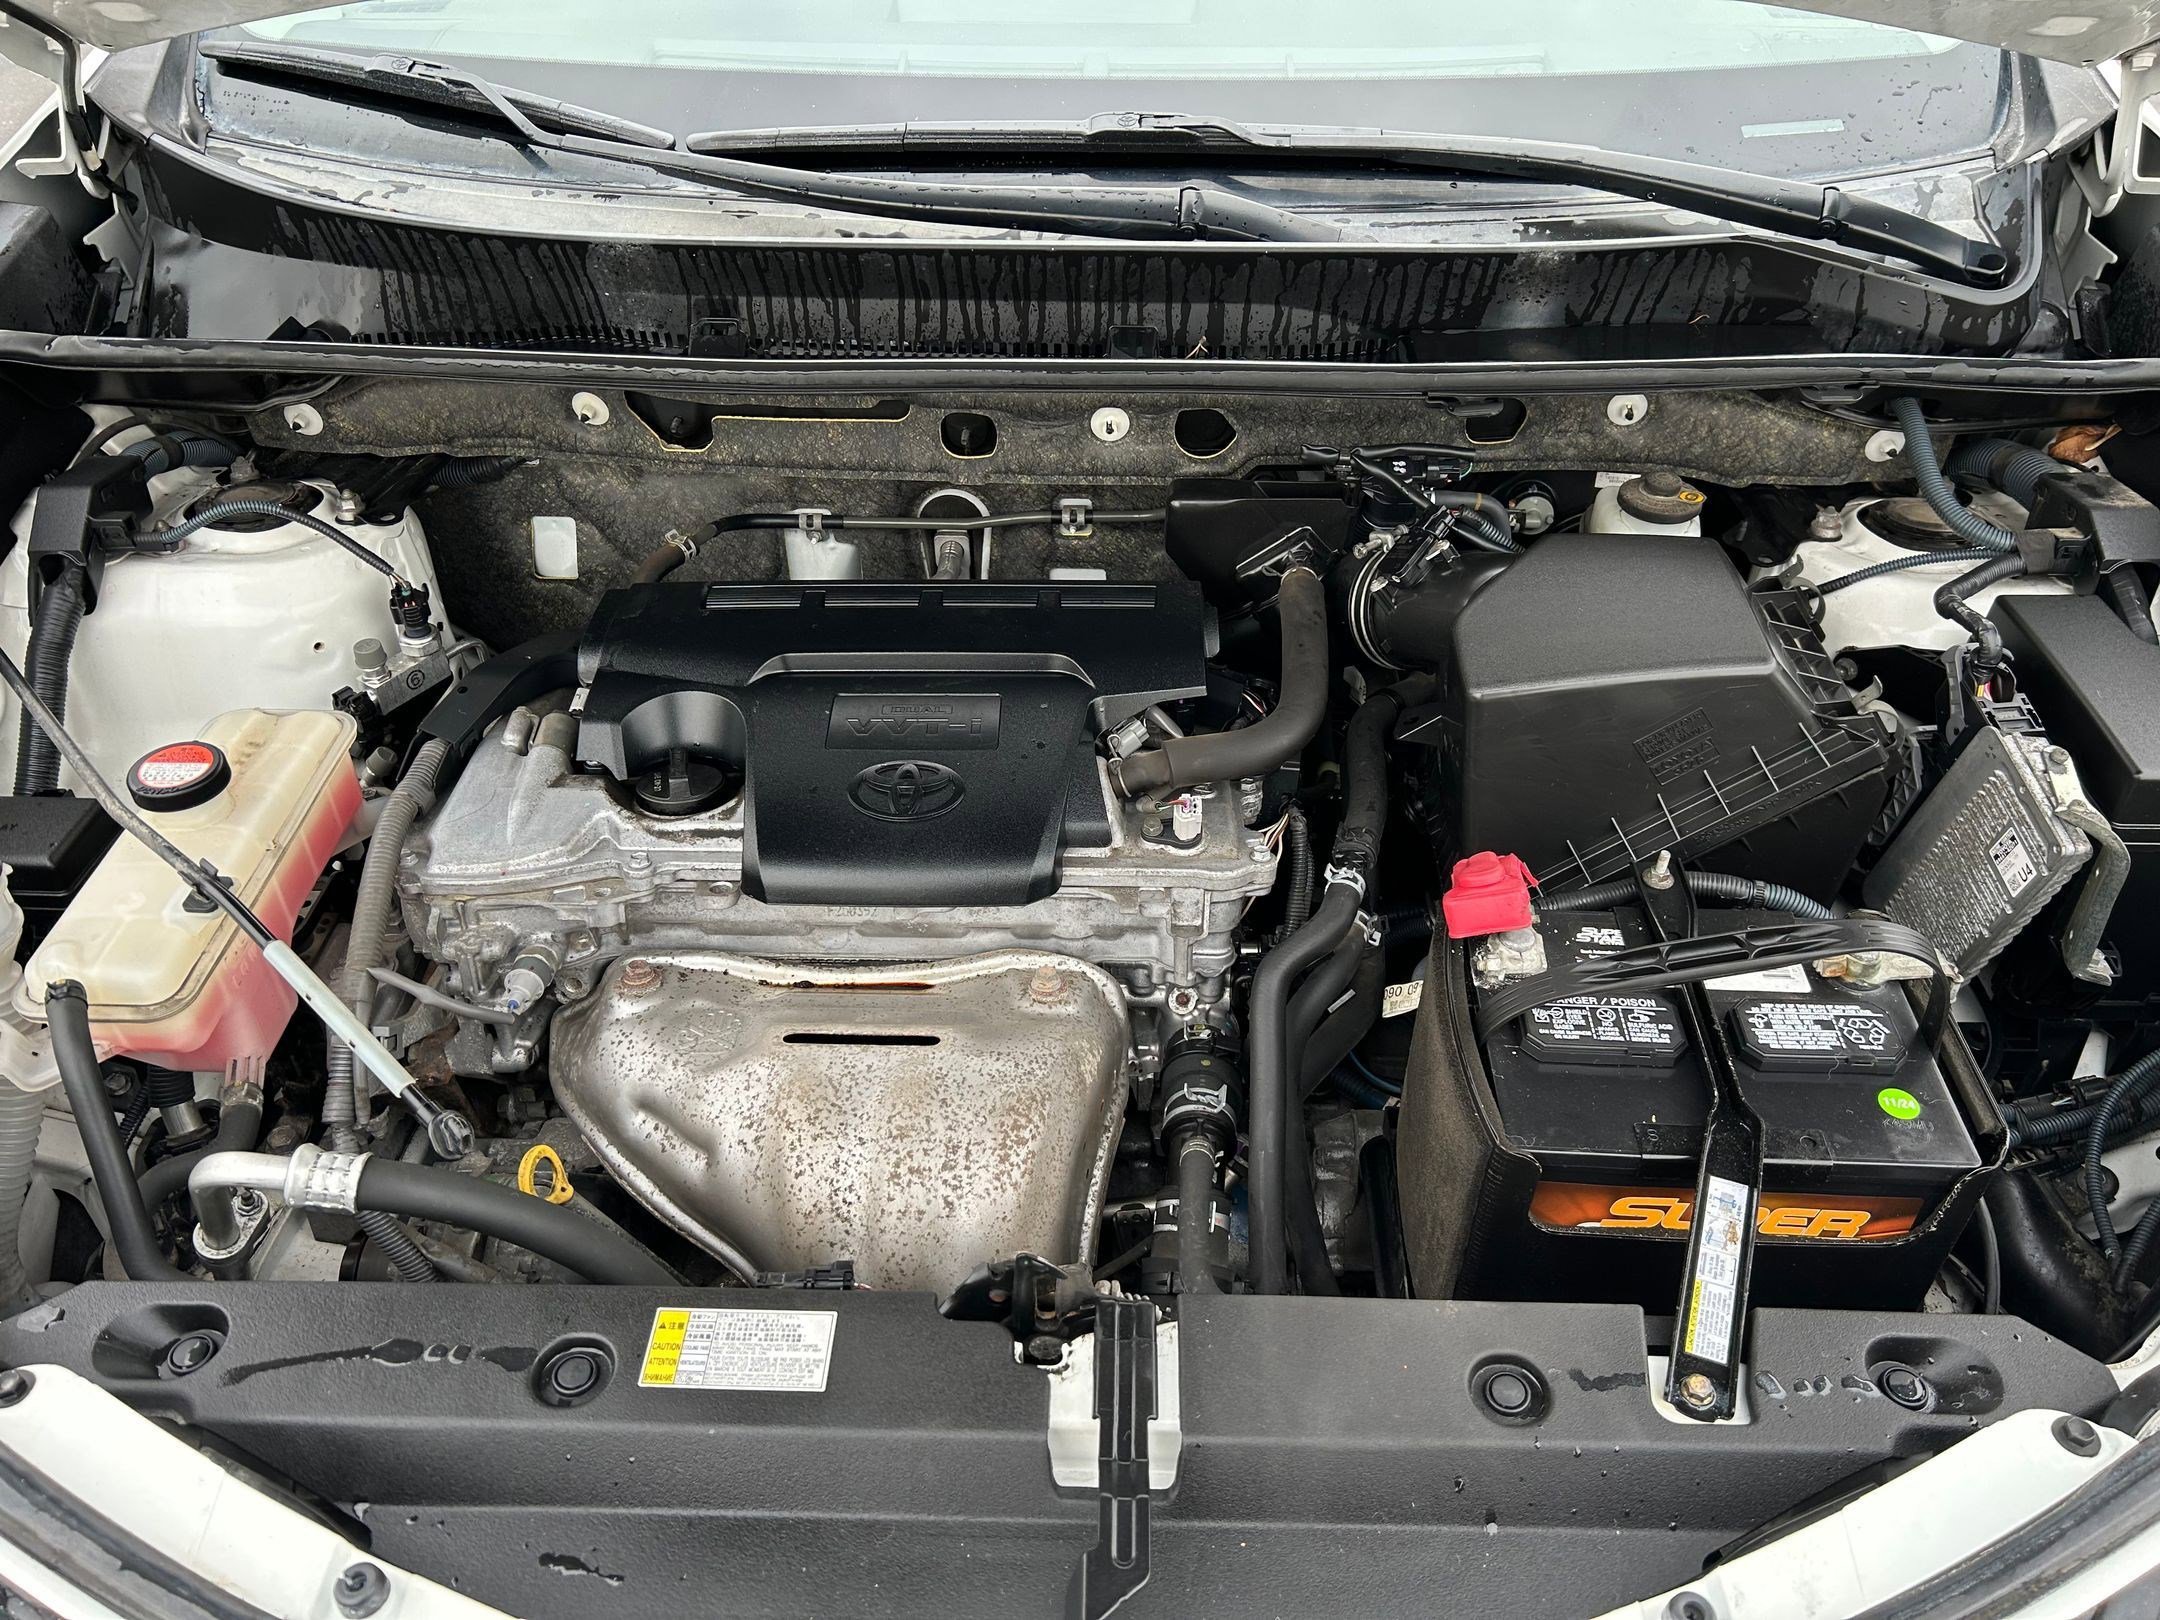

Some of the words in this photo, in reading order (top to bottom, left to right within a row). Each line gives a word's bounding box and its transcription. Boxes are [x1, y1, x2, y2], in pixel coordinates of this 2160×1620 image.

[890, 704, 947, 713] DUAL
[2018, 863, 2033, 882] U4
[1552, 996, 1598, 1005] ANGER
[1611, 997, 1656, 1007] POISON
[1882, 1097, 1917, 1110] 11/24
[652, 1342, 681, 1351] CAUTION
[649, 1357, 677, 1366] ATTENTION
